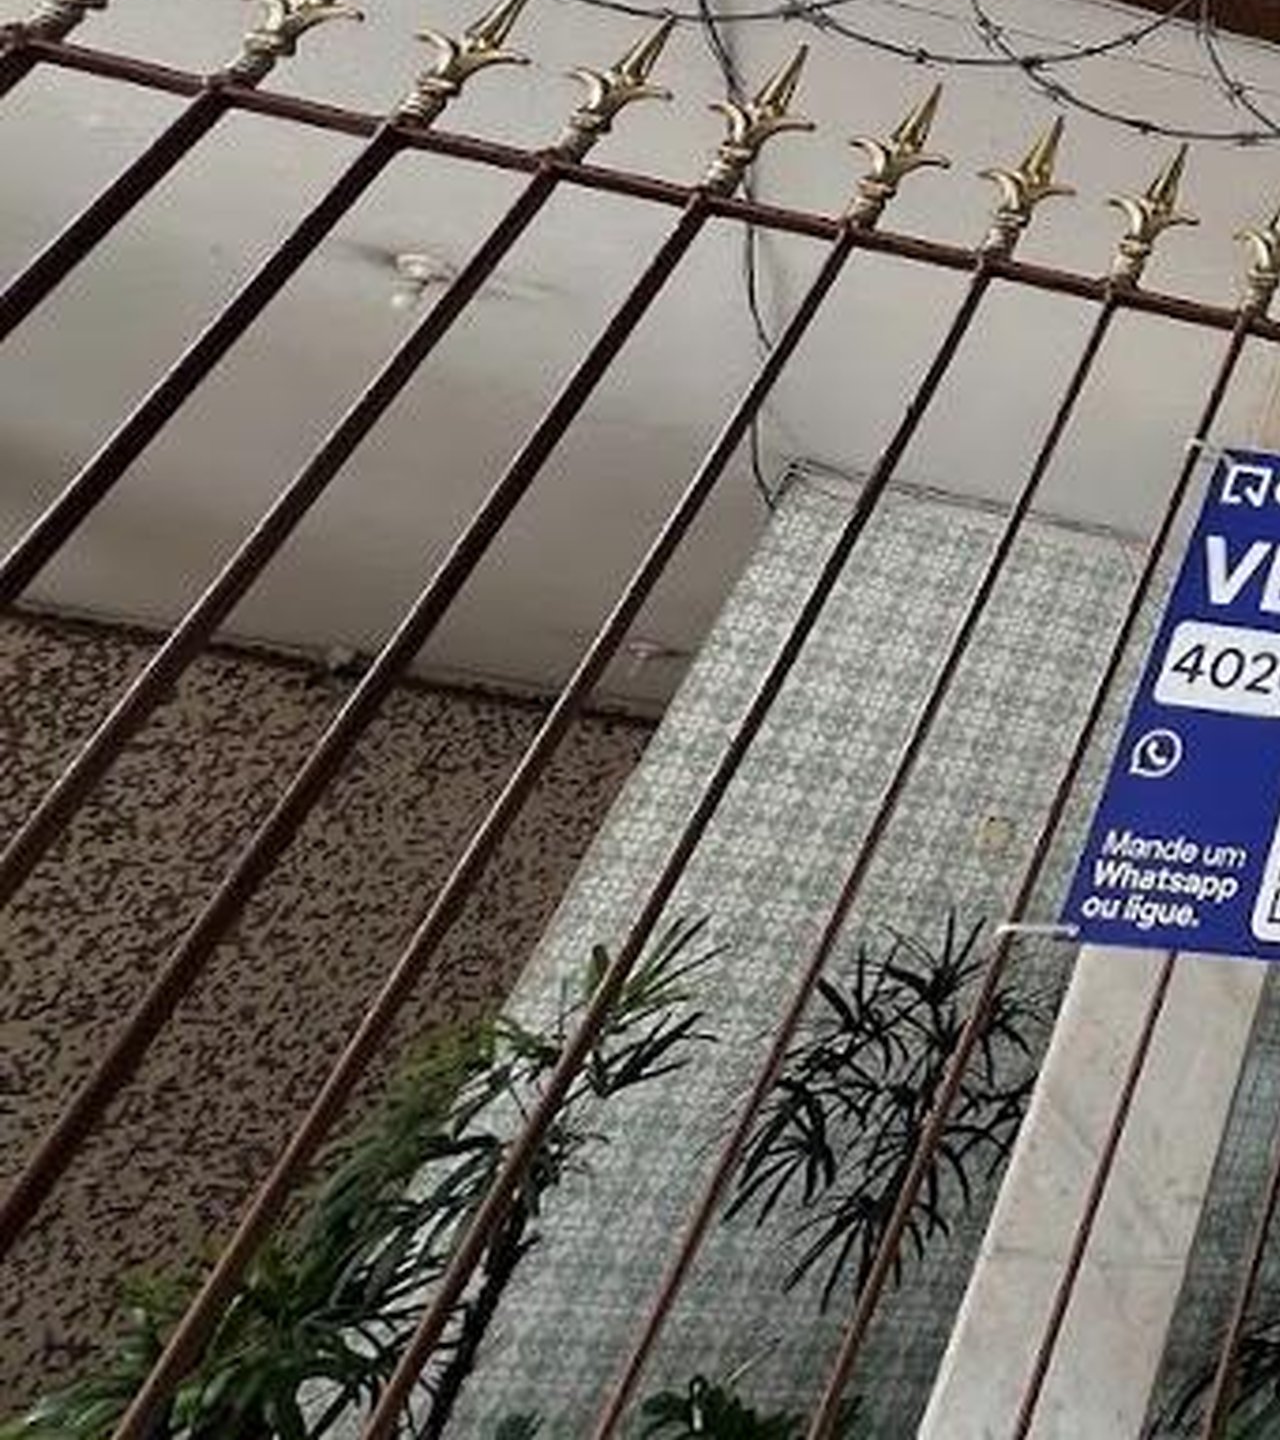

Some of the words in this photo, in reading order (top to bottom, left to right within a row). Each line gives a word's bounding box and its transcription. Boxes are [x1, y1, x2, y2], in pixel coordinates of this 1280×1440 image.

[1102, 830, 1200, 864] Mande
[1203, 845, 1248, 869] um
[1094, 860, 1239, 904] Whatsapp
[1081, 896, 1121, 920] ou
[1122, 894, 1200, 930] ligue.
